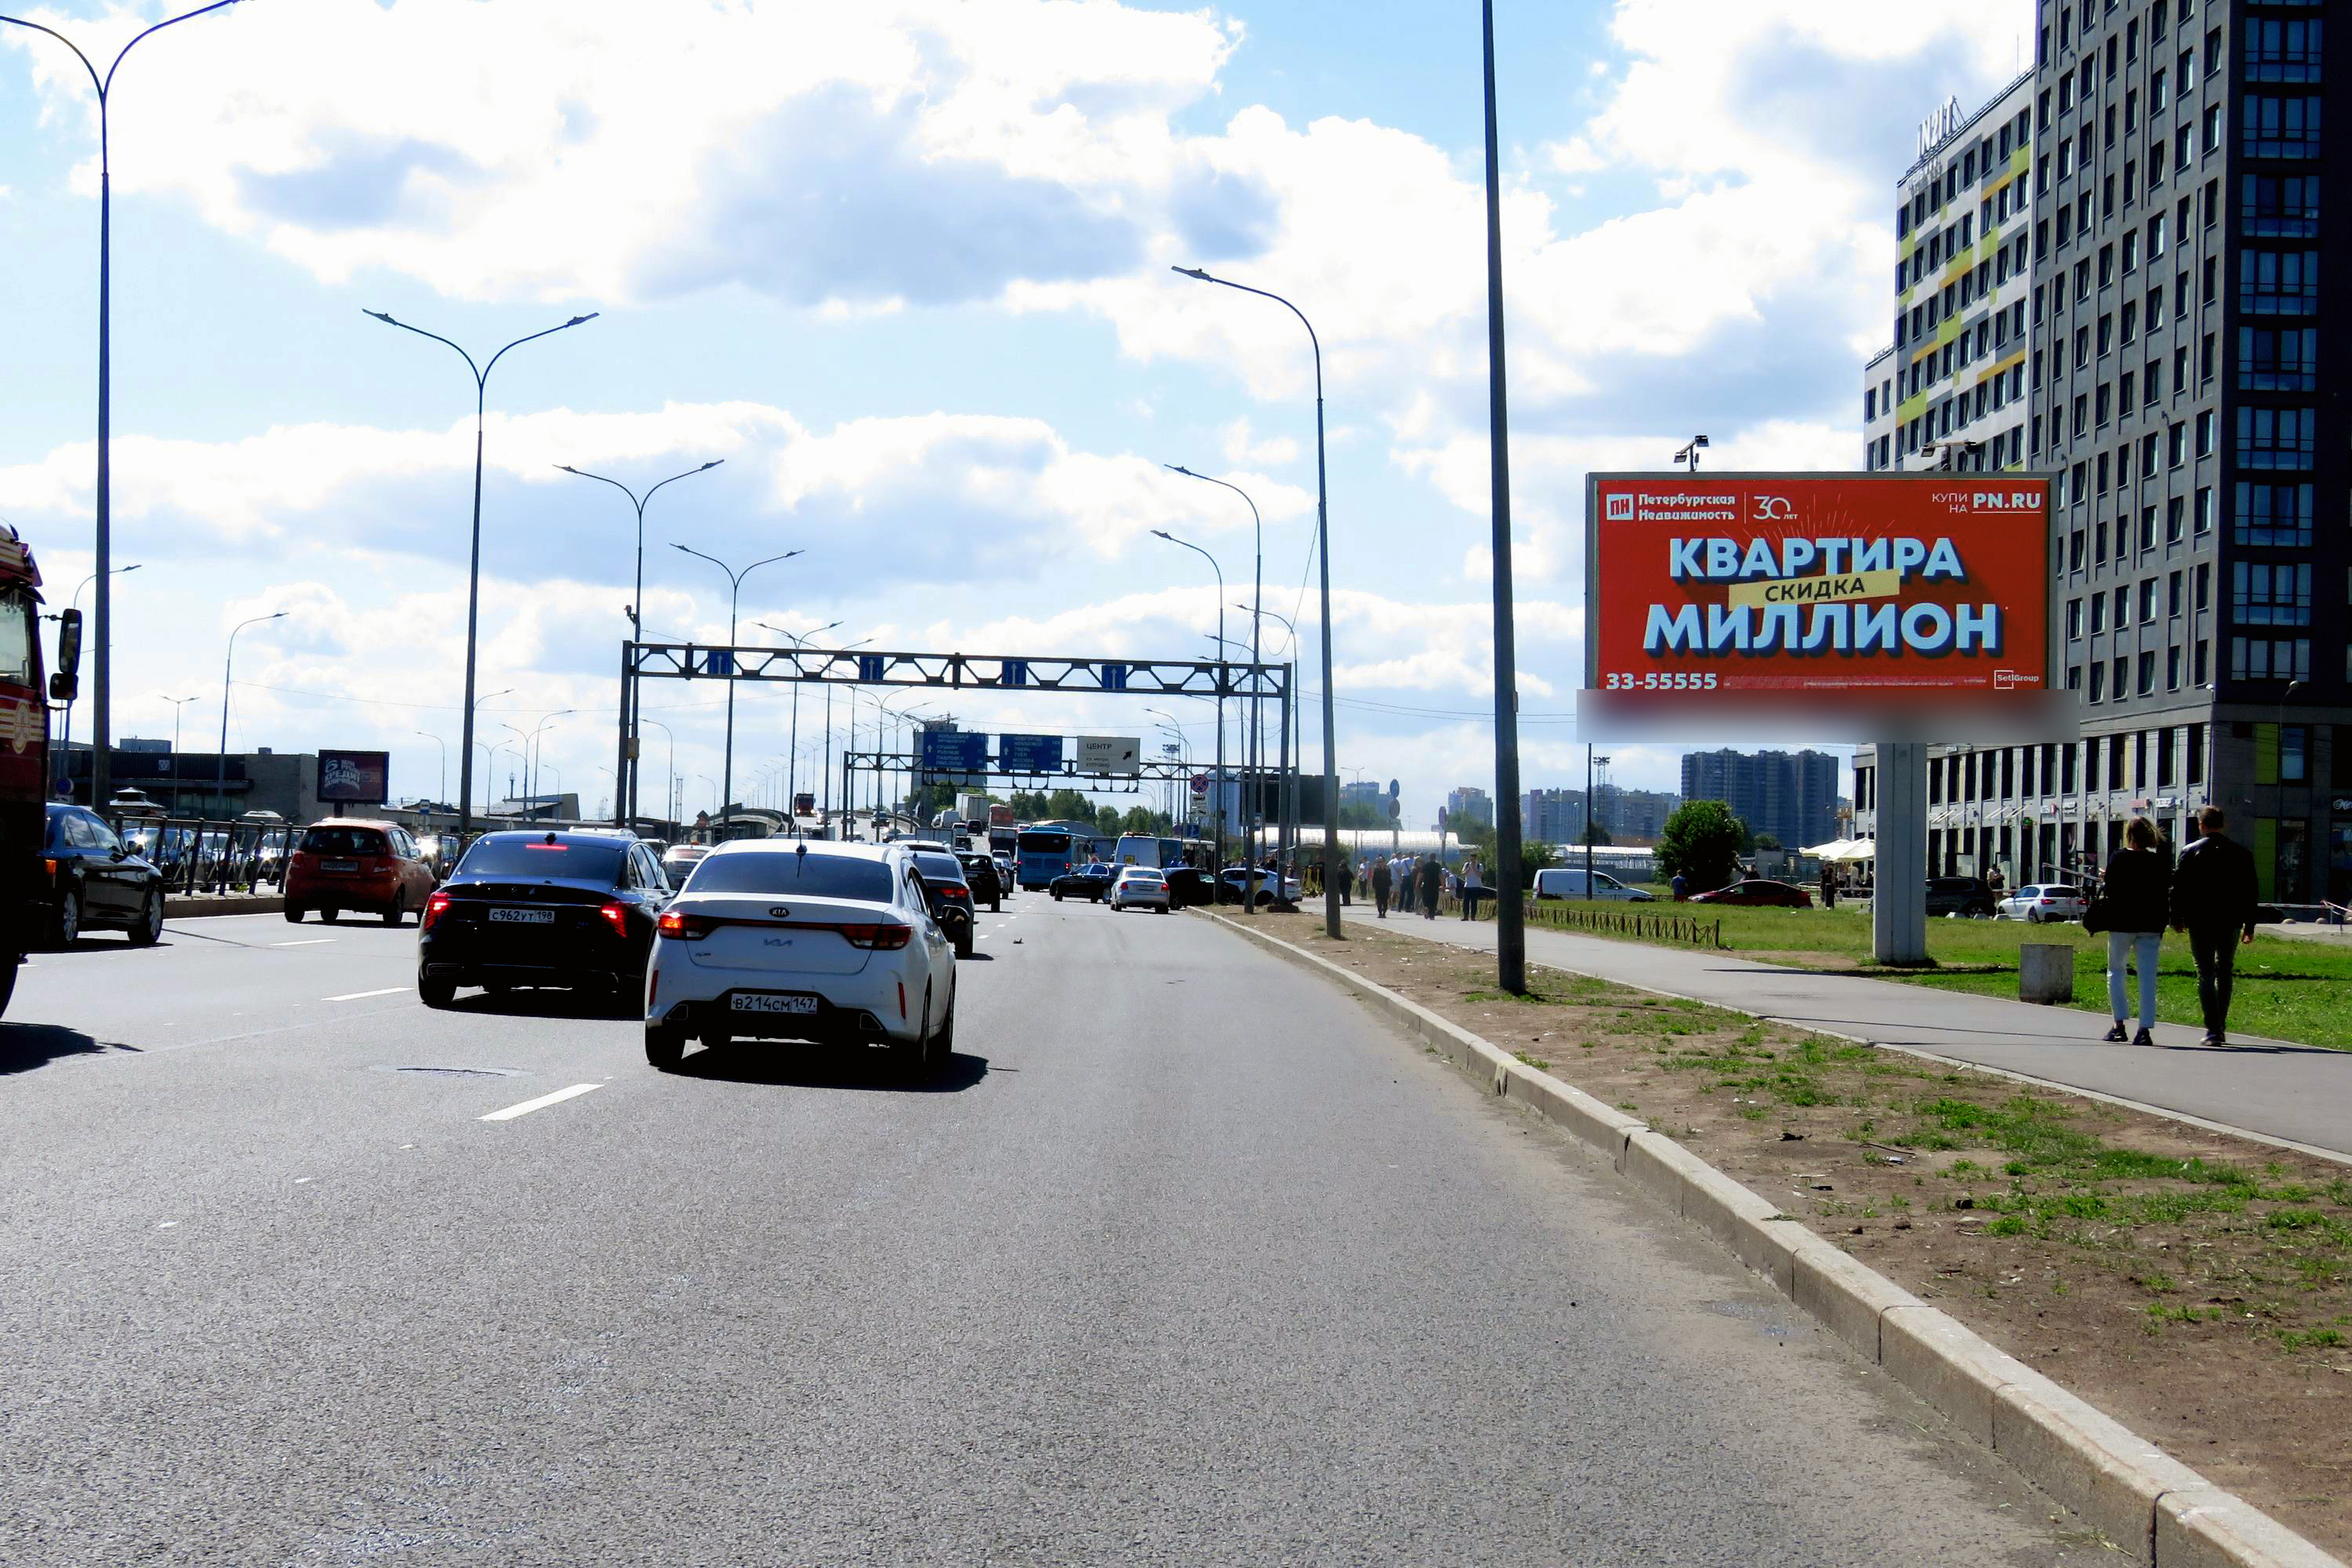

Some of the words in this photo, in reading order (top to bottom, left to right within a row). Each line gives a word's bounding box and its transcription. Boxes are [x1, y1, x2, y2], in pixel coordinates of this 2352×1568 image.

[1638, 493, 1736, 506] Петербургская
[1932, 493, 1968, 503] КУПИ
[1973, 492, 2042, 509] PN.RU
[1638, 509, 1735, 521] Недвижимость
[1753, 495, 1791, 520] 30
[1949, 504, 1968, 514] НА
[1669, 537, 1965, 579] КВАРТИРА
[1765, 577, 1866, 603] СКИДКА
[1643, 602, 1998, 652] МИЛЛИОН
[1606, 673, 1718, 690] 33-55555
[537, 911, 553, 920] 198
[793, 997, 814, 1009] 147
